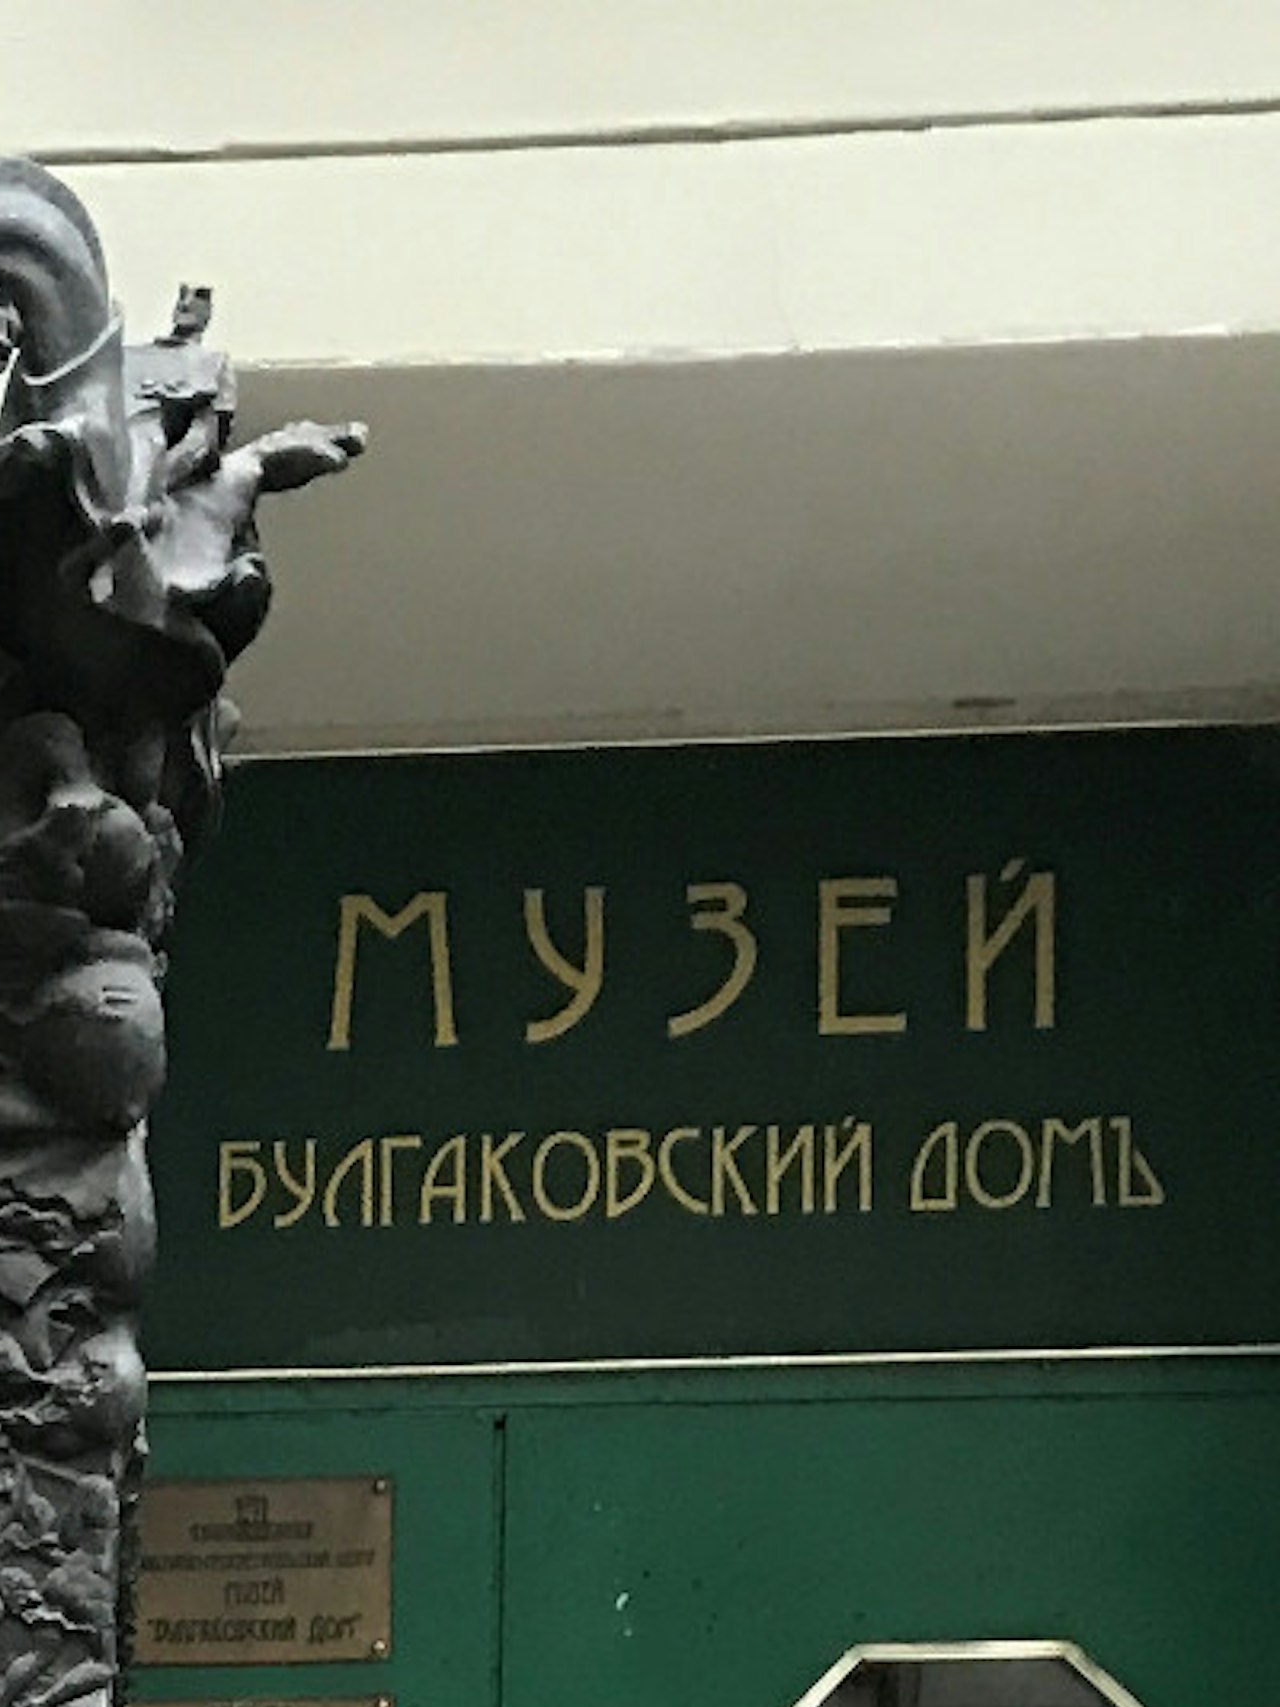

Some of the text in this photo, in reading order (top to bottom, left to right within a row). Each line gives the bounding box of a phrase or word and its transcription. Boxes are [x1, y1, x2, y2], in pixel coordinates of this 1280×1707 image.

[325, 858, 1056, 1052] МУЗЕЙ
[217, 1114, 1167, 1229] БУЛГАКОВСКИЙ ДОМЪ
